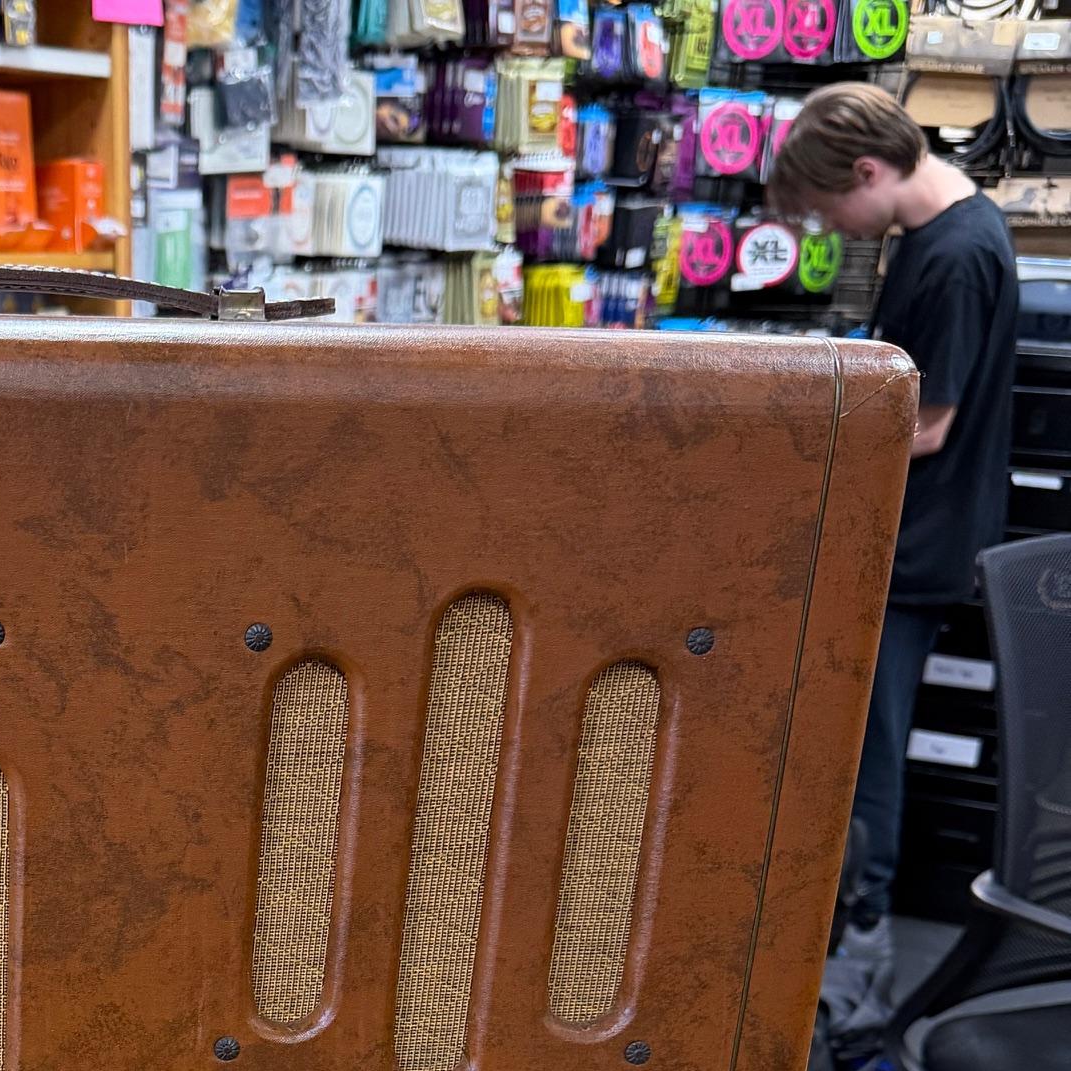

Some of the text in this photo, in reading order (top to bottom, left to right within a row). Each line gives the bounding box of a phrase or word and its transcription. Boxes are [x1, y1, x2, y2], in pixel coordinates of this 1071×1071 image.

[737, 7, 771, 35] XL
[865, 7, 898, 35] XL
[749, 239, 787, 264] XL
